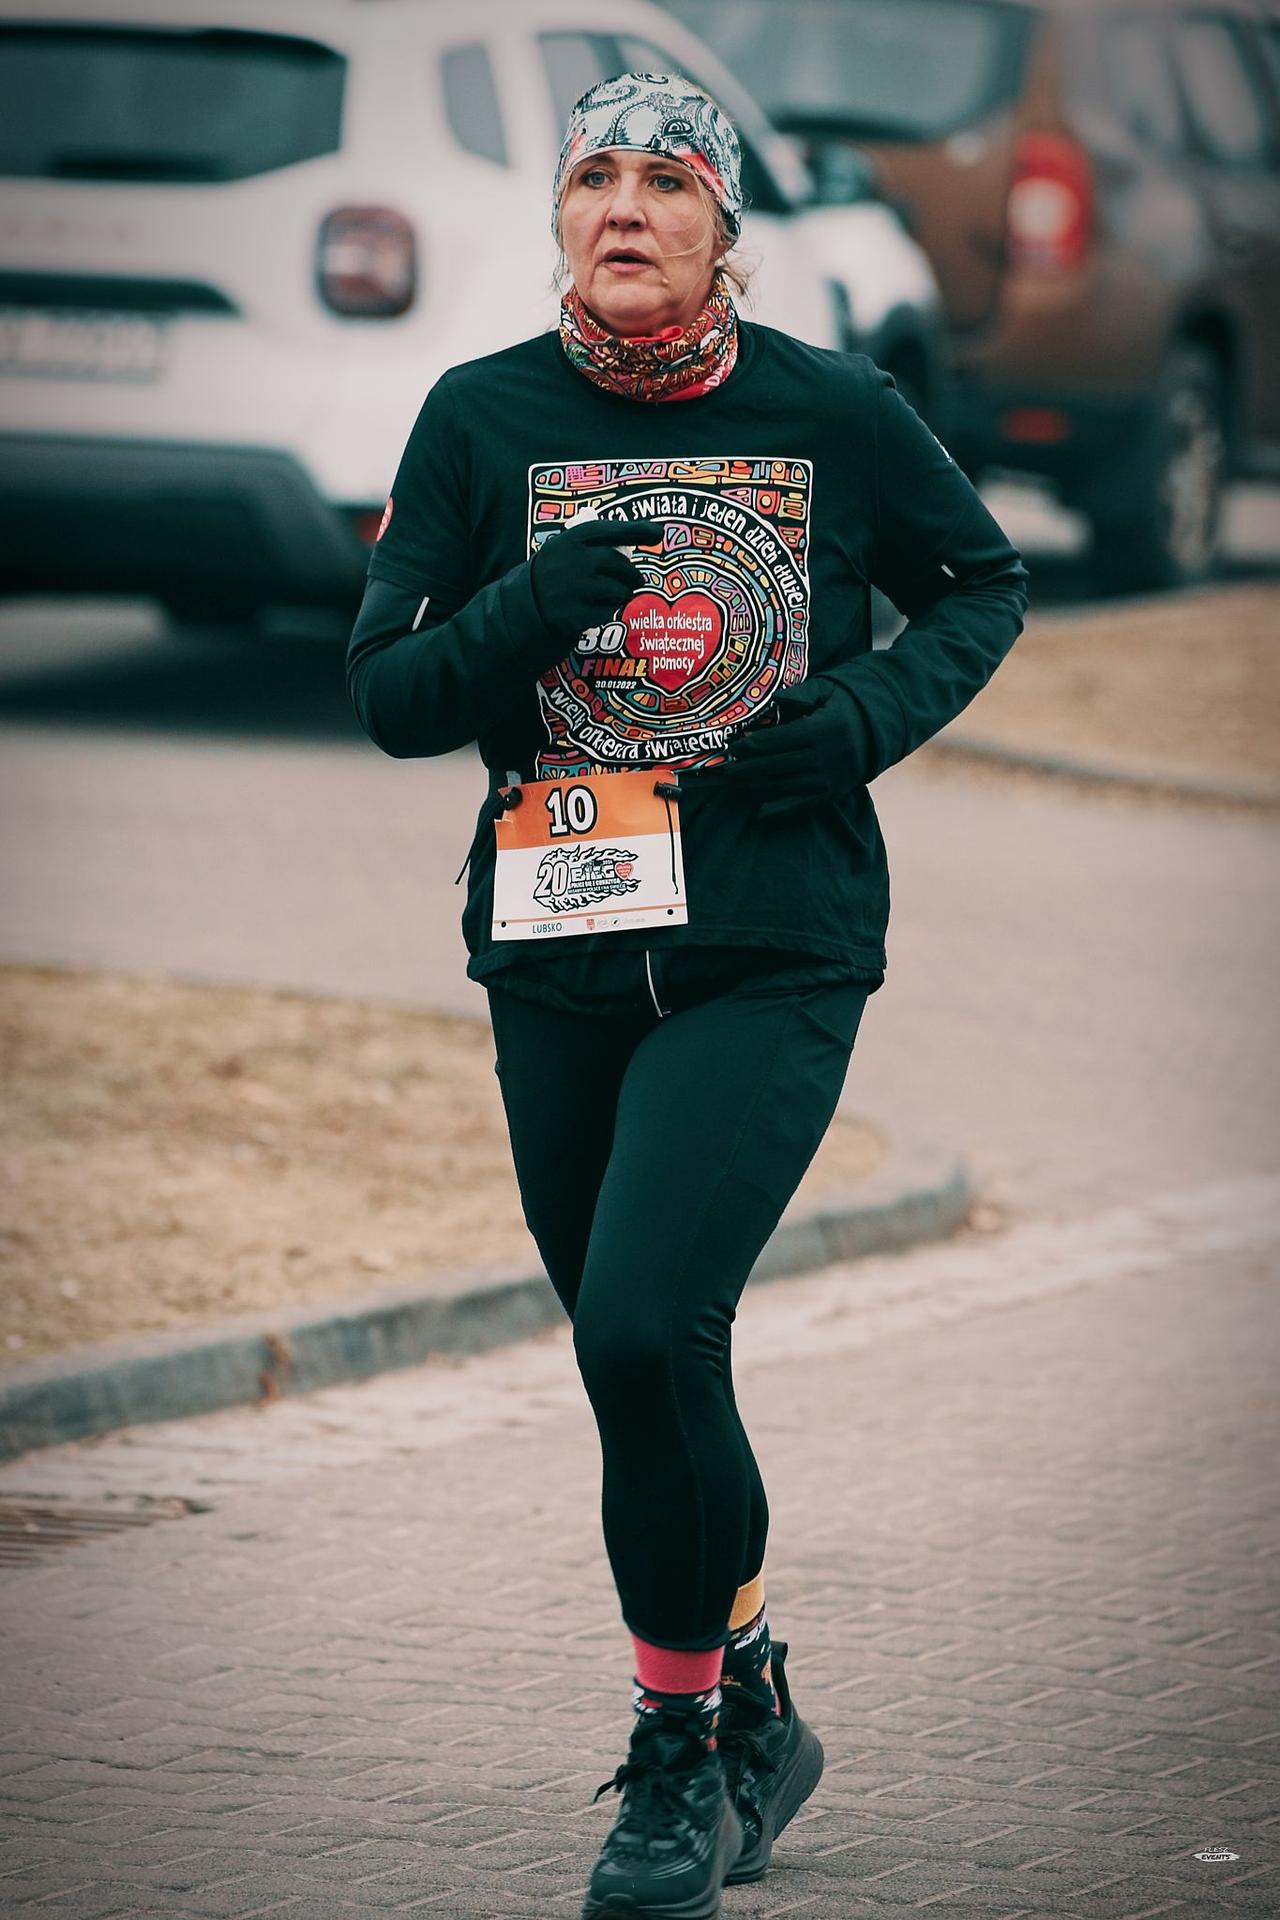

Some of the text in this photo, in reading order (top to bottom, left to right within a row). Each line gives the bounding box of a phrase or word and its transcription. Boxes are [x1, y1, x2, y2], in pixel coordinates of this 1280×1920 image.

[691, 497, 698, 517] i
[700, 499, 747, 534] jeden
[629, 608, 713, 632] wielka orkiestra
[576, 622, 626, 653] 30
[639, 631, 705, 660] świątecznej
[581, 658, 648, 677] FINAŁ
[652, 655, 695, 676] pomocy
[595, 680, 637, 690] 30.01.2022
[546, 784, 598, 838] 10
[533, 860, 569, 899] 20
[532, 922, 562, 934] LUBSKO
